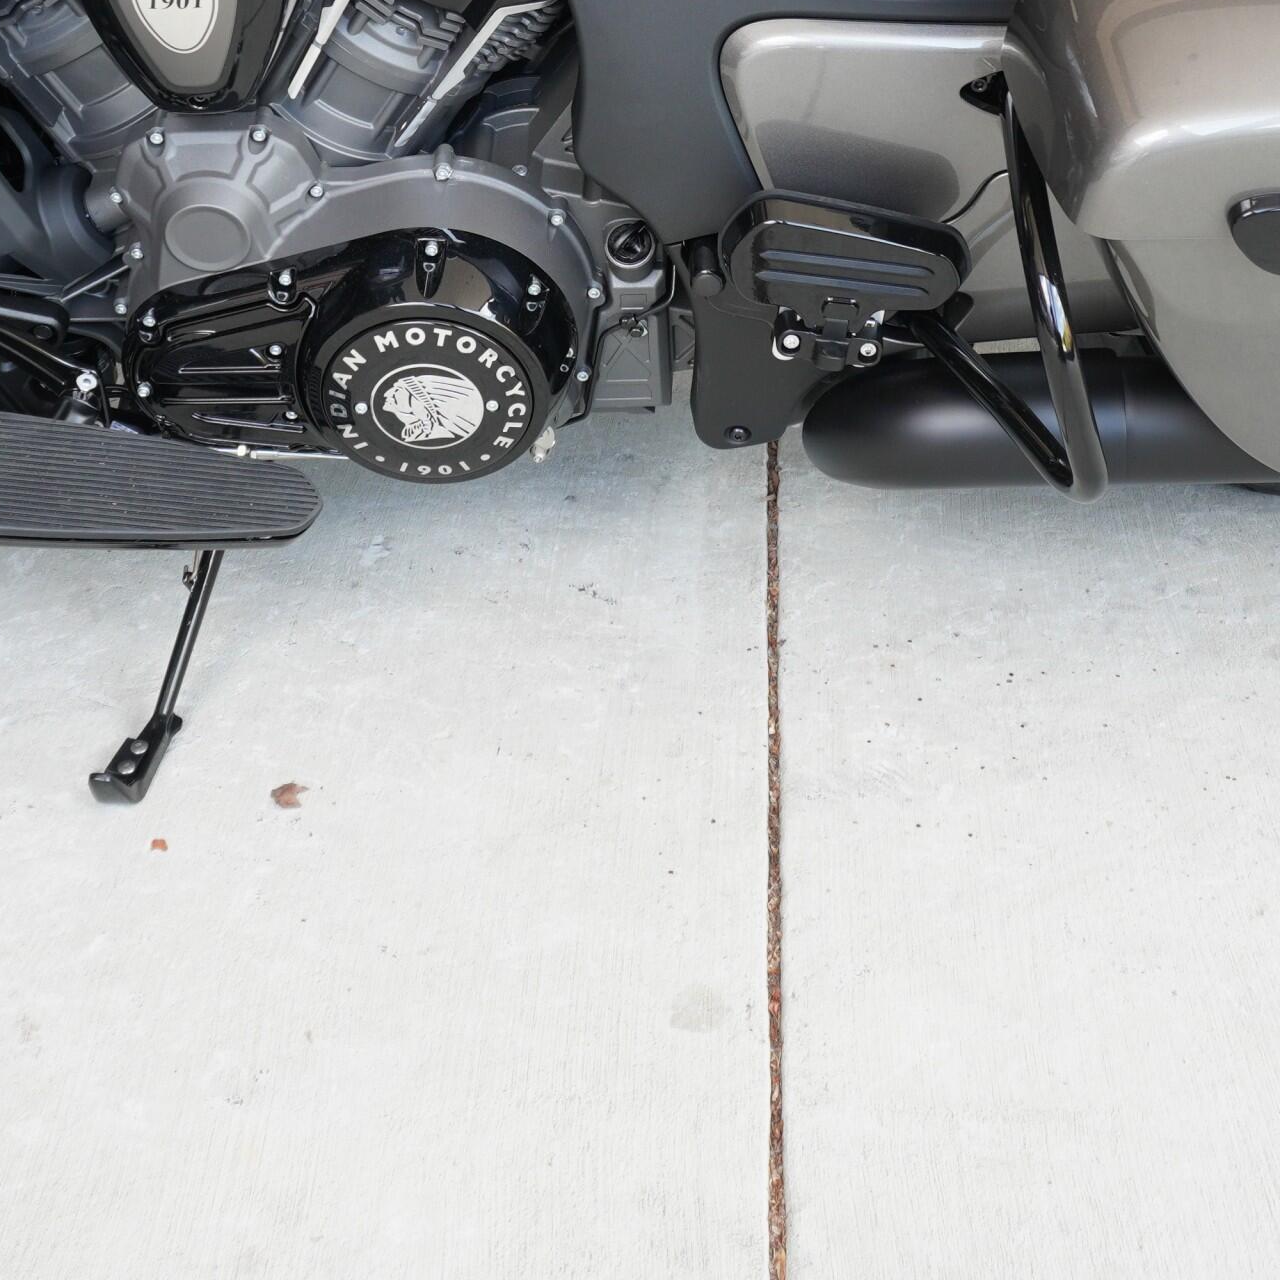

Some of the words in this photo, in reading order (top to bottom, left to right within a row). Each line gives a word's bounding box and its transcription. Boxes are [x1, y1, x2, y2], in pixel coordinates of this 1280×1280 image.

[330, 348, 368, 450] INDIAN
[373, 327, 526, 449] MOTORCYCLE
[399, 460, 471, 476] 1901
